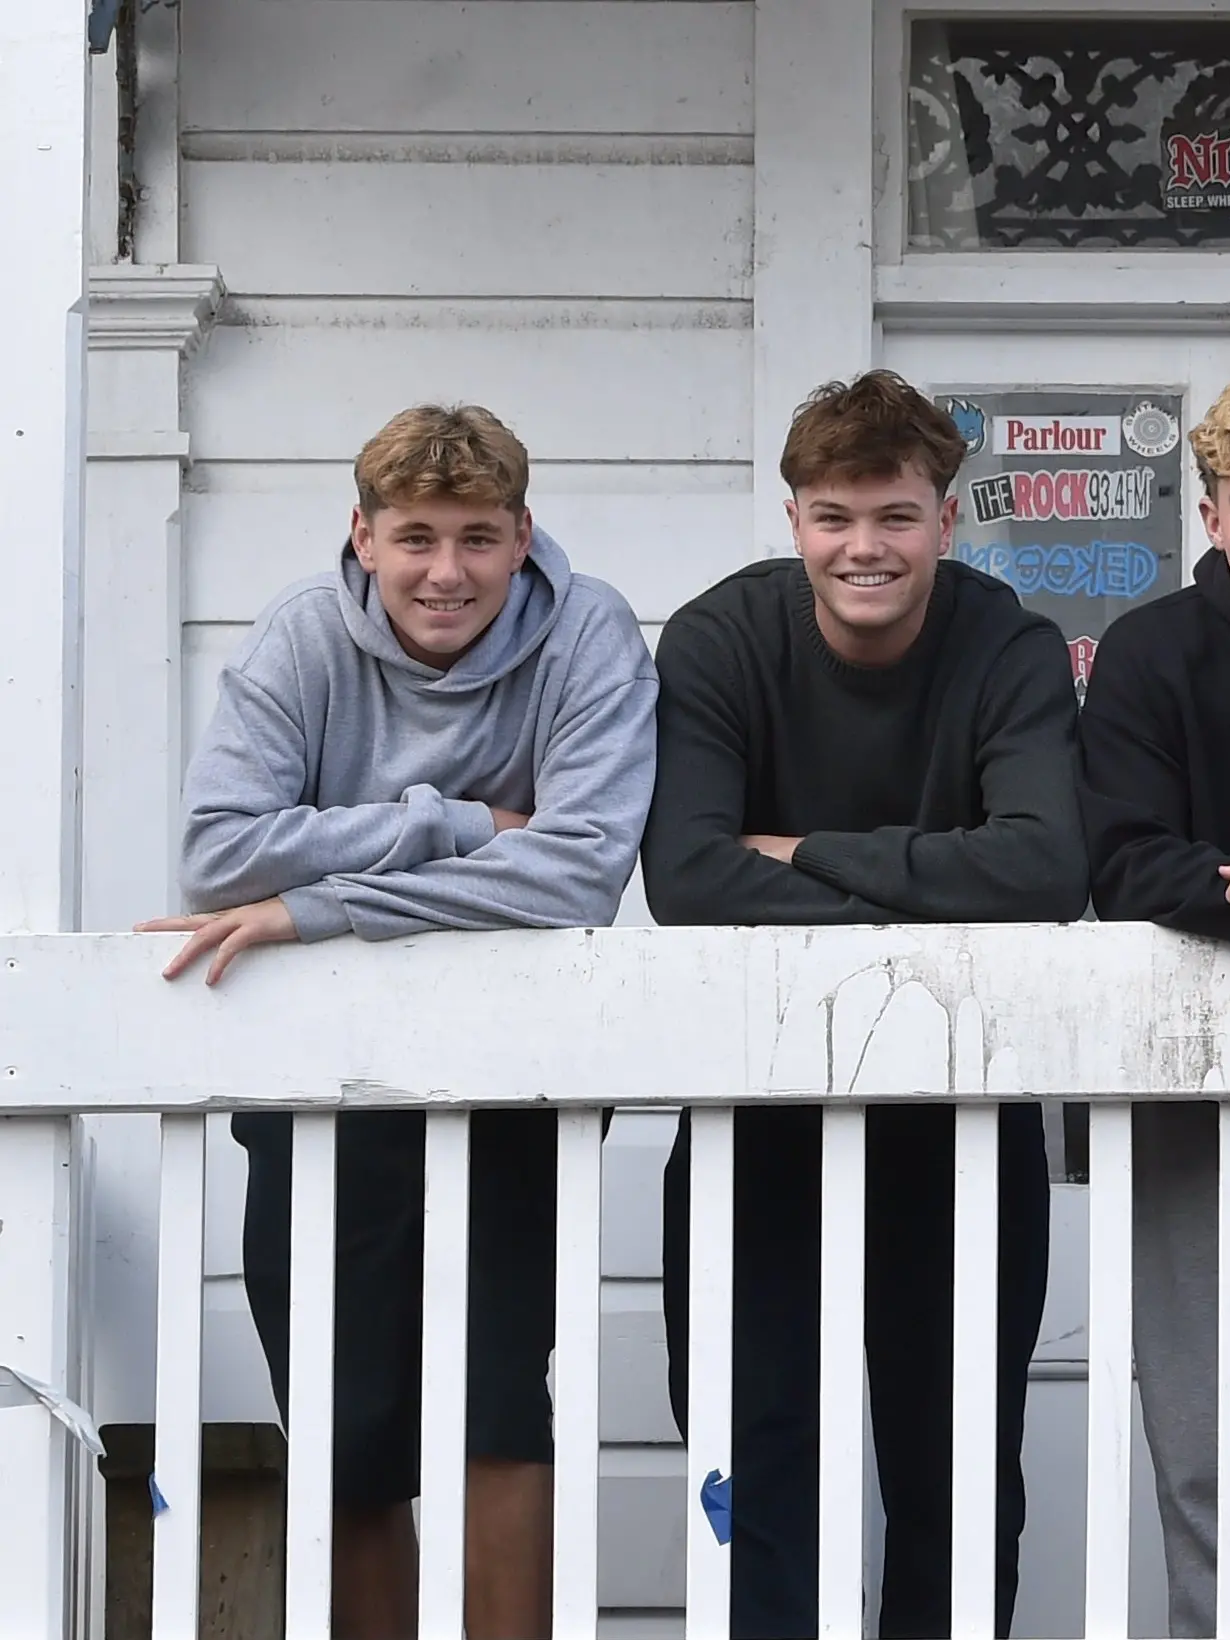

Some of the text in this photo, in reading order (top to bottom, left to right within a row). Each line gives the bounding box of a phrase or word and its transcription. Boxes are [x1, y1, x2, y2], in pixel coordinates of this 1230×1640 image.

[1167, 196, 1203, 208] SLEEP
[1006, 419, 1106, 451] Parlour
[972, 480, 1013, 520] THE
[1014, 472, 1089, 518] ROCK
